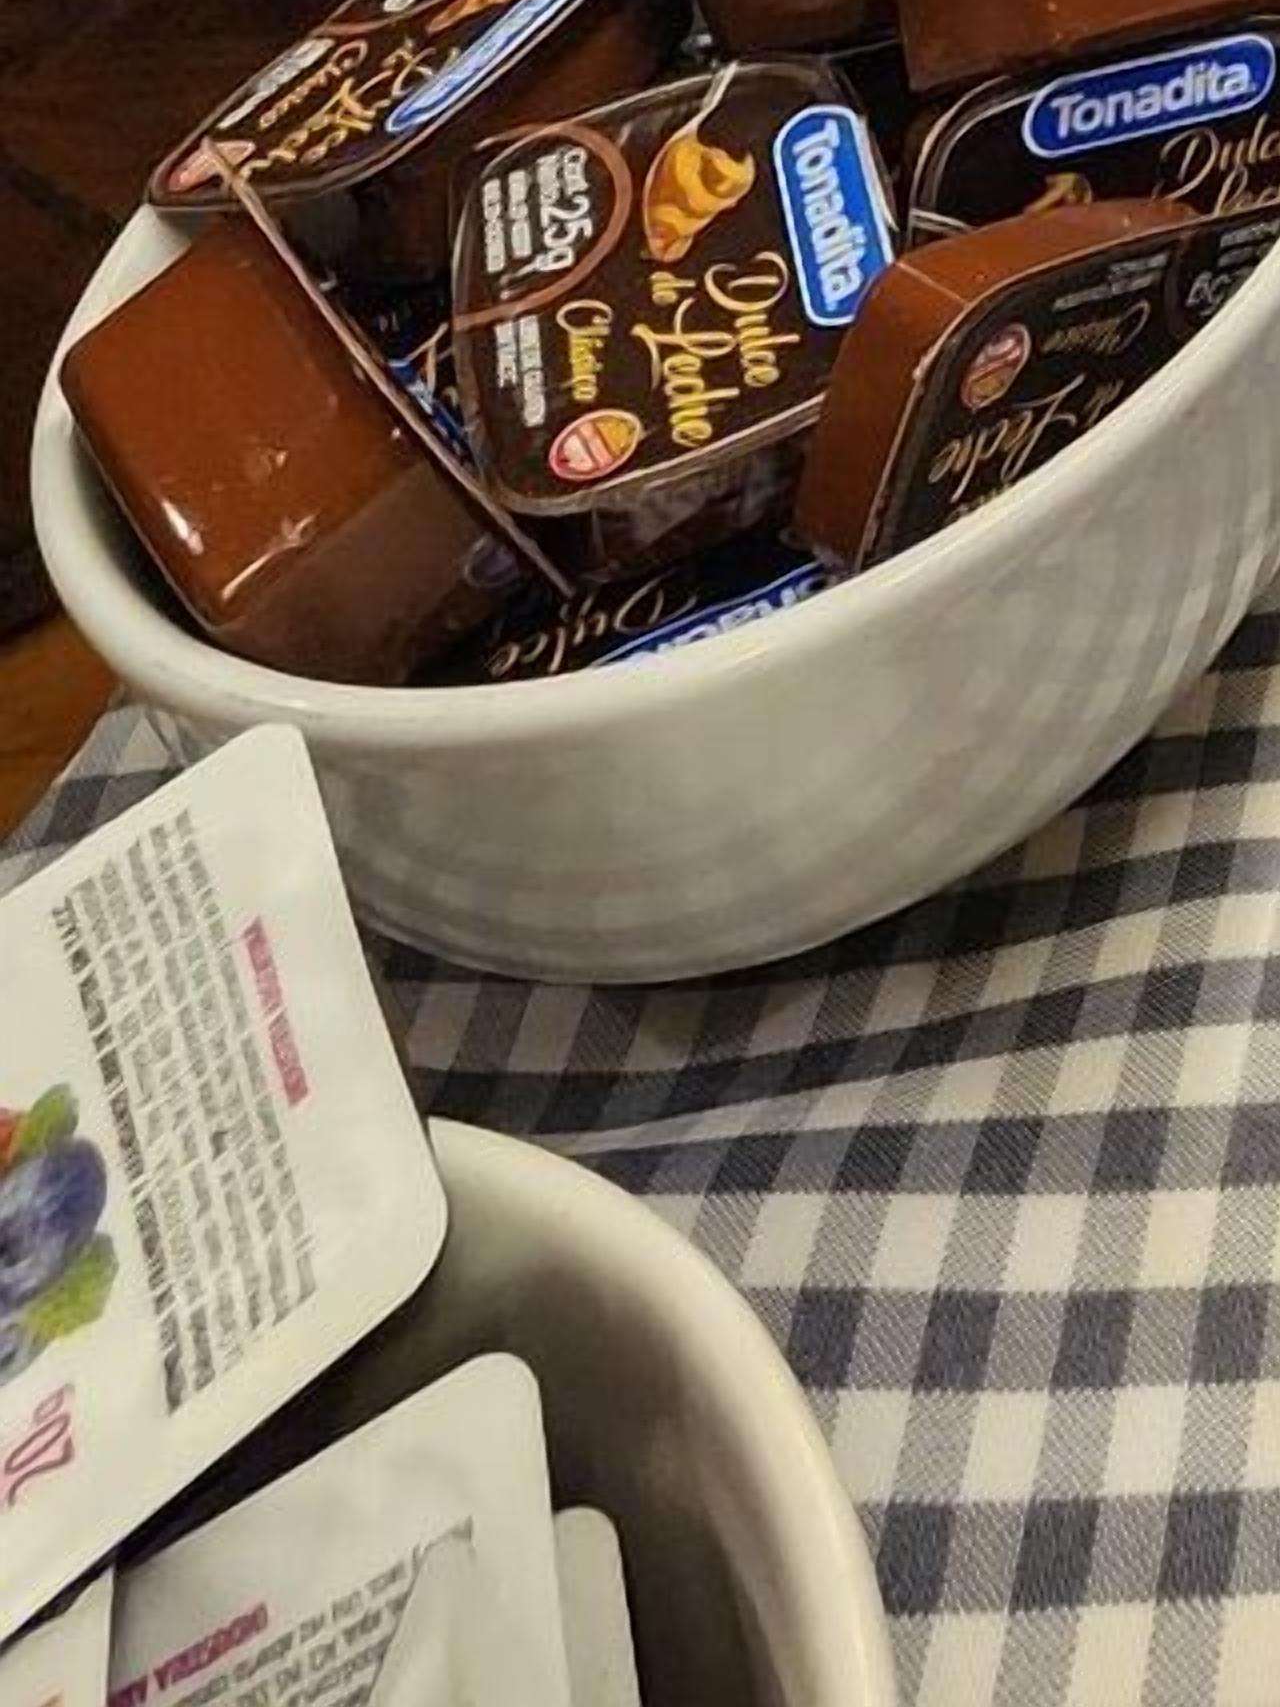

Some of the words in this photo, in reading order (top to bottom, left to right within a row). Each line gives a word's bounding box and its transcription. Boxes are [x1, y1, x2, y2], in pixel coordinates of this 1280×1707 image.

[1051, 59, 1252, 138] Tonadita
[537, 196, 594, 274] 25g
[794, 118, 867, 311] Tonadita
[649, 271, 696, 306] de
[705, 251, 800, 387] Dulce
[631, 298, 740, 447] Leche
[5, 1384, 75, 1507] 20g
